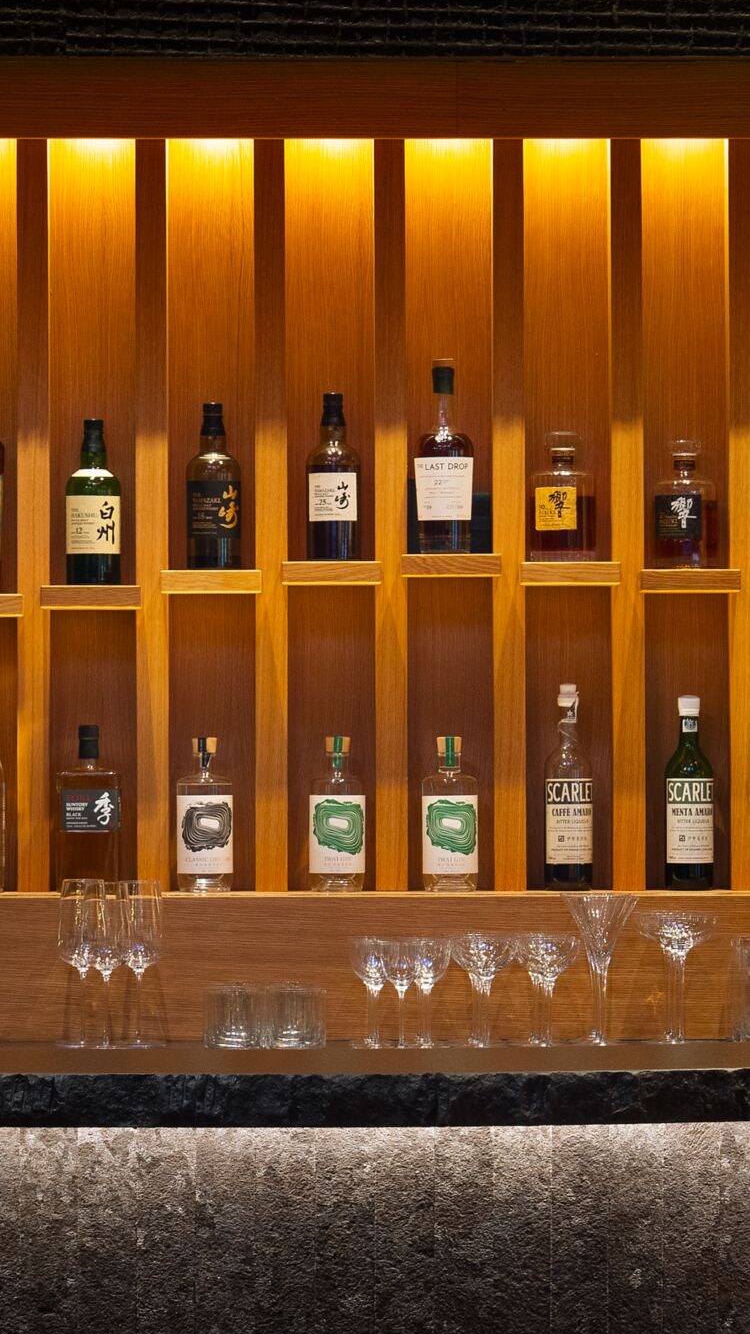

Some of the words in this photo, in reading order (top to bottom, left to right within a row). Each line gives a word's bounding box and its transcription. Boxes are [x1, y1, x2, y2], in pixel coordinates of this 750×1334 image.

[447, 462, 469, 470] DROP
[96, 500, 116, 545] 白州
[93, 791, 115, 826] 季
[672, 808, 693, 816] MENTA
